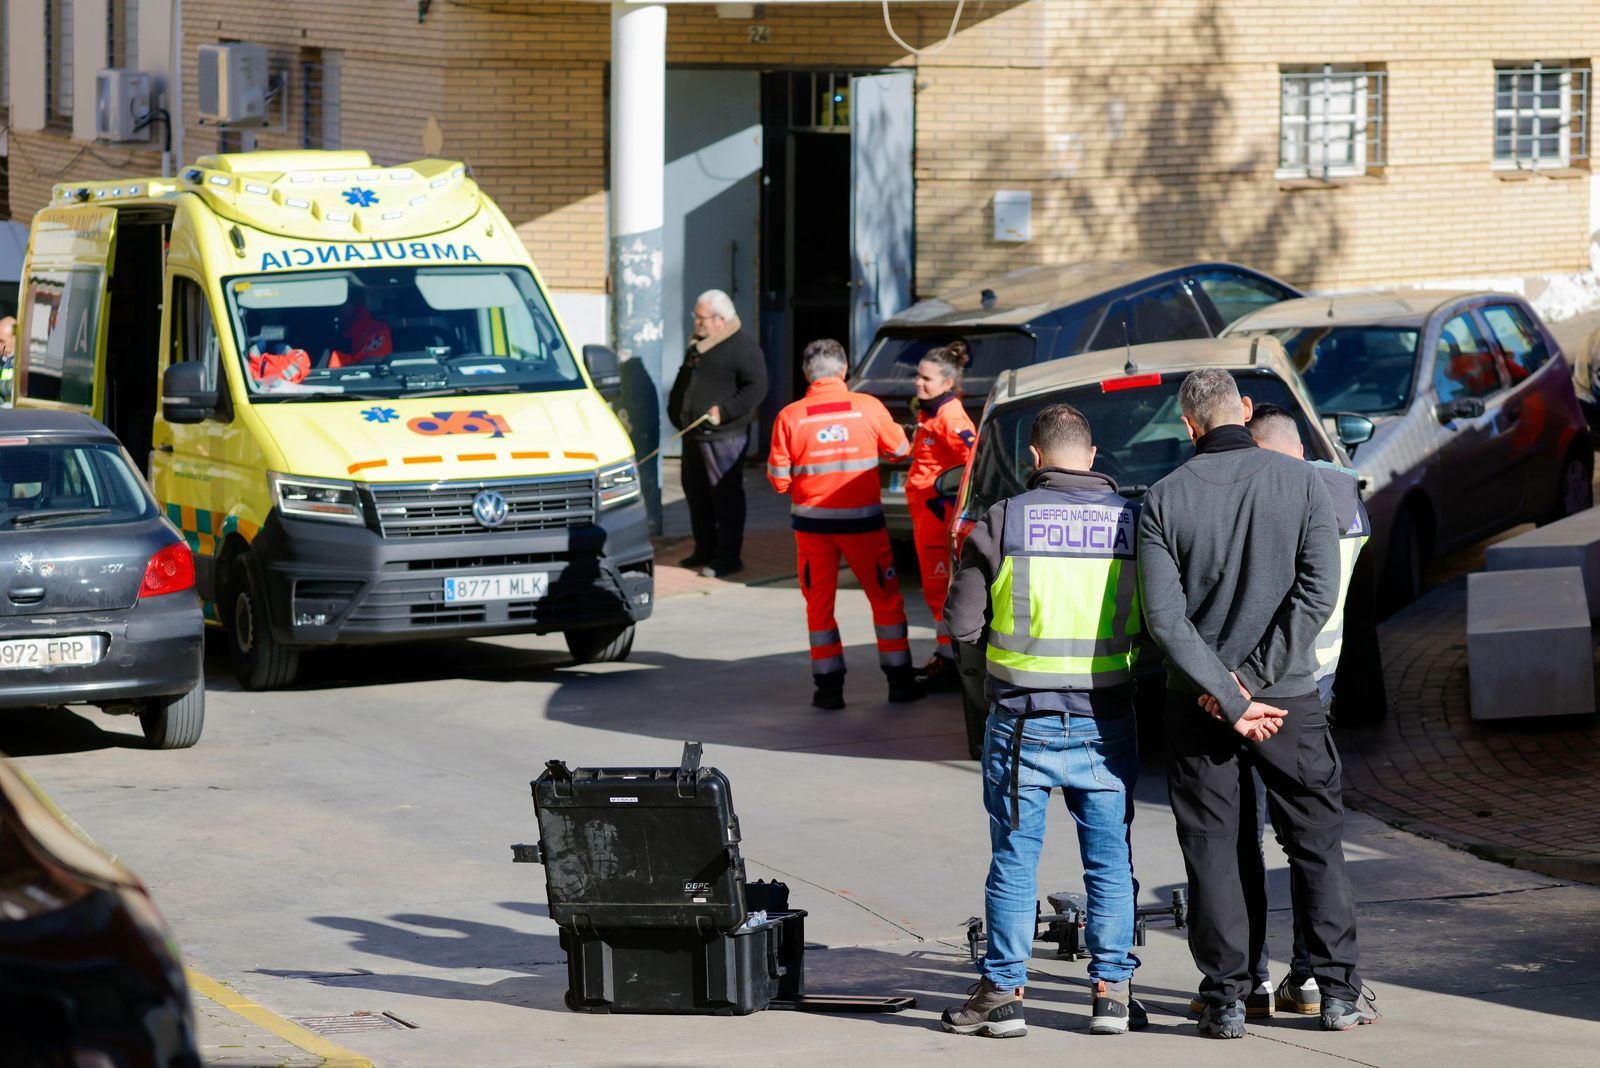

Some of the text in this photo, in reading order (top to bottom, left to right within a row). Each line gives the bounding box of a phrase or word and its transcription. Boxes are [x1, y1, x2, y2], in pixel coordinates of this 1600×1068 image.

[406, 410, 513, 438] 061
[1029, 508, 1130, 524] CUERPO NACIONAL DE
[1029, 523, 1129, 550] POLICIA
[99, 563, 124, 574] 307
[457, 576, 543, 598] 8771 MLK
[0, 641, 84, 664] 972 FRP
